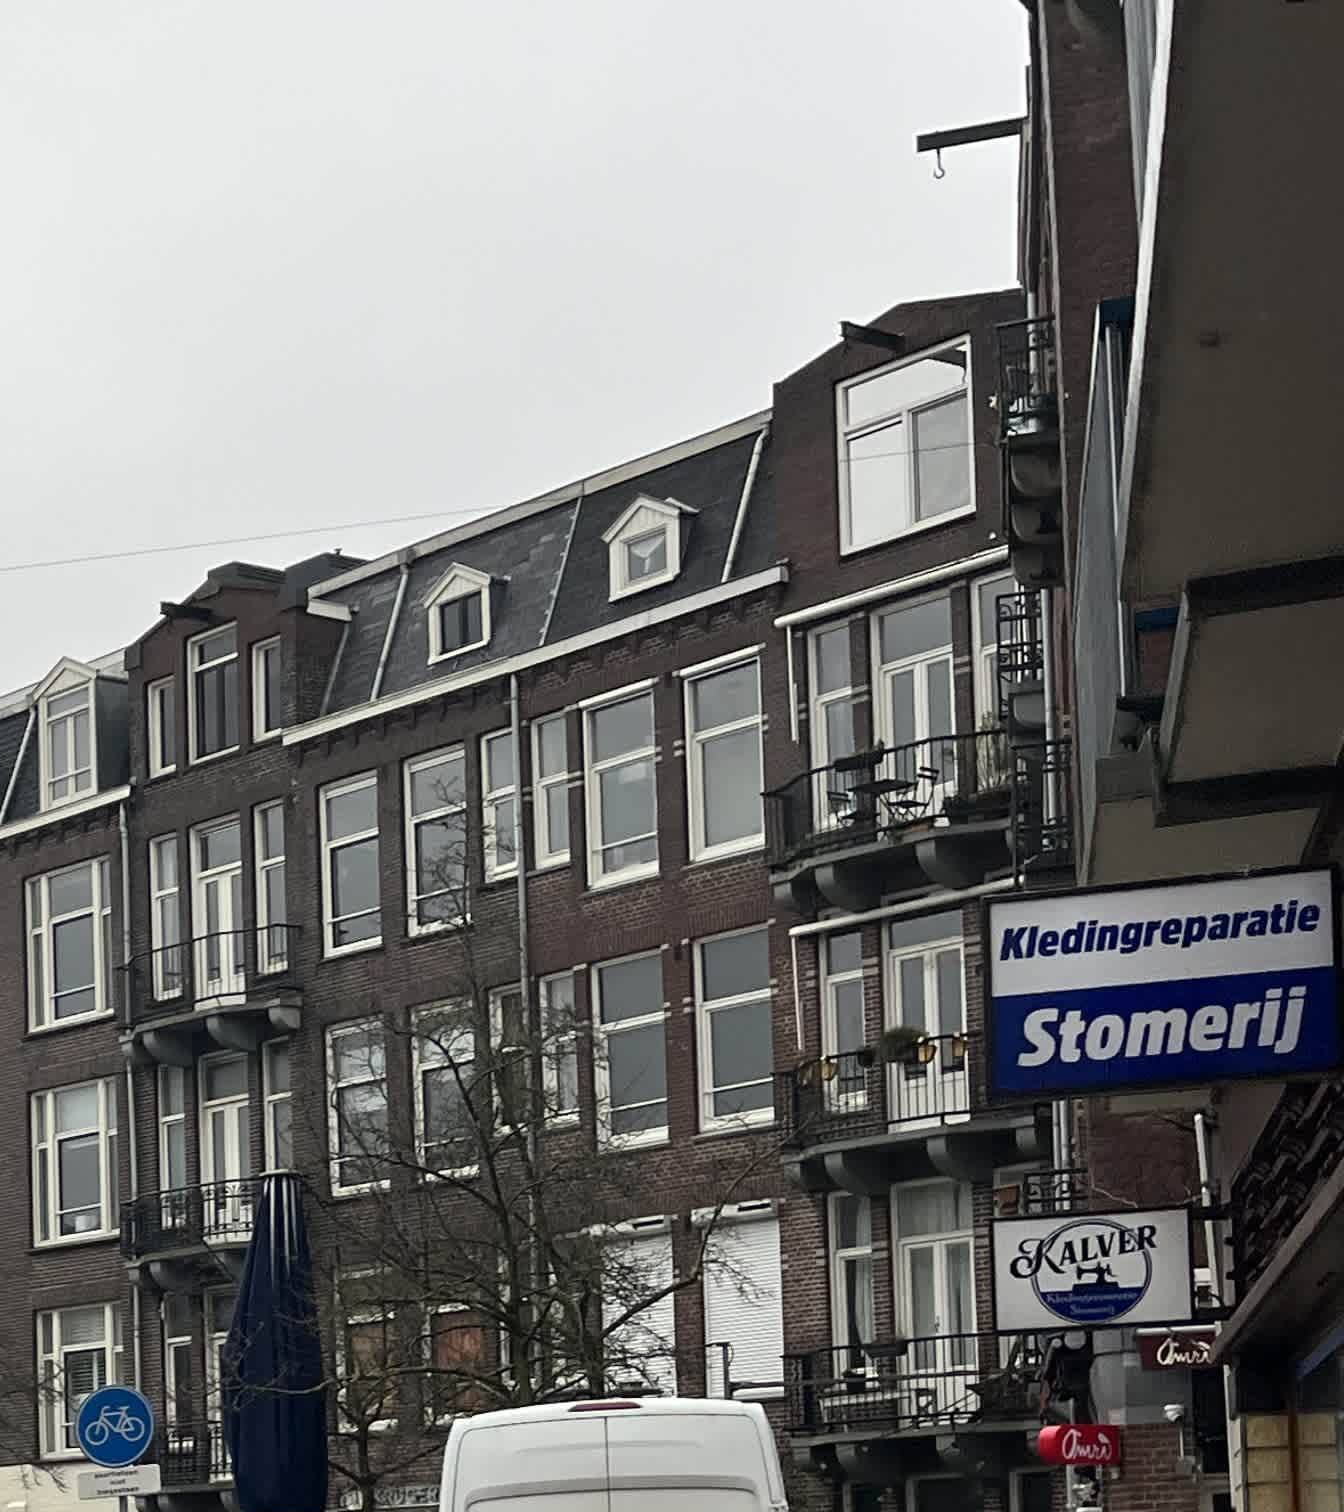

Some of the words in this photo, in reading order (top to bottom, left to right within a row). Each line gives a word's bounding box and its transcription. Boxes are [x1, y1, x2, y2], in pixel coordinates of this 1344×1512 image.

[1000, 900, 1320, 961] Kledingreparatie
[1017, 986, 1306, 1067] Stomerij
[1010, 1225, 1157, 1278] KALVER
